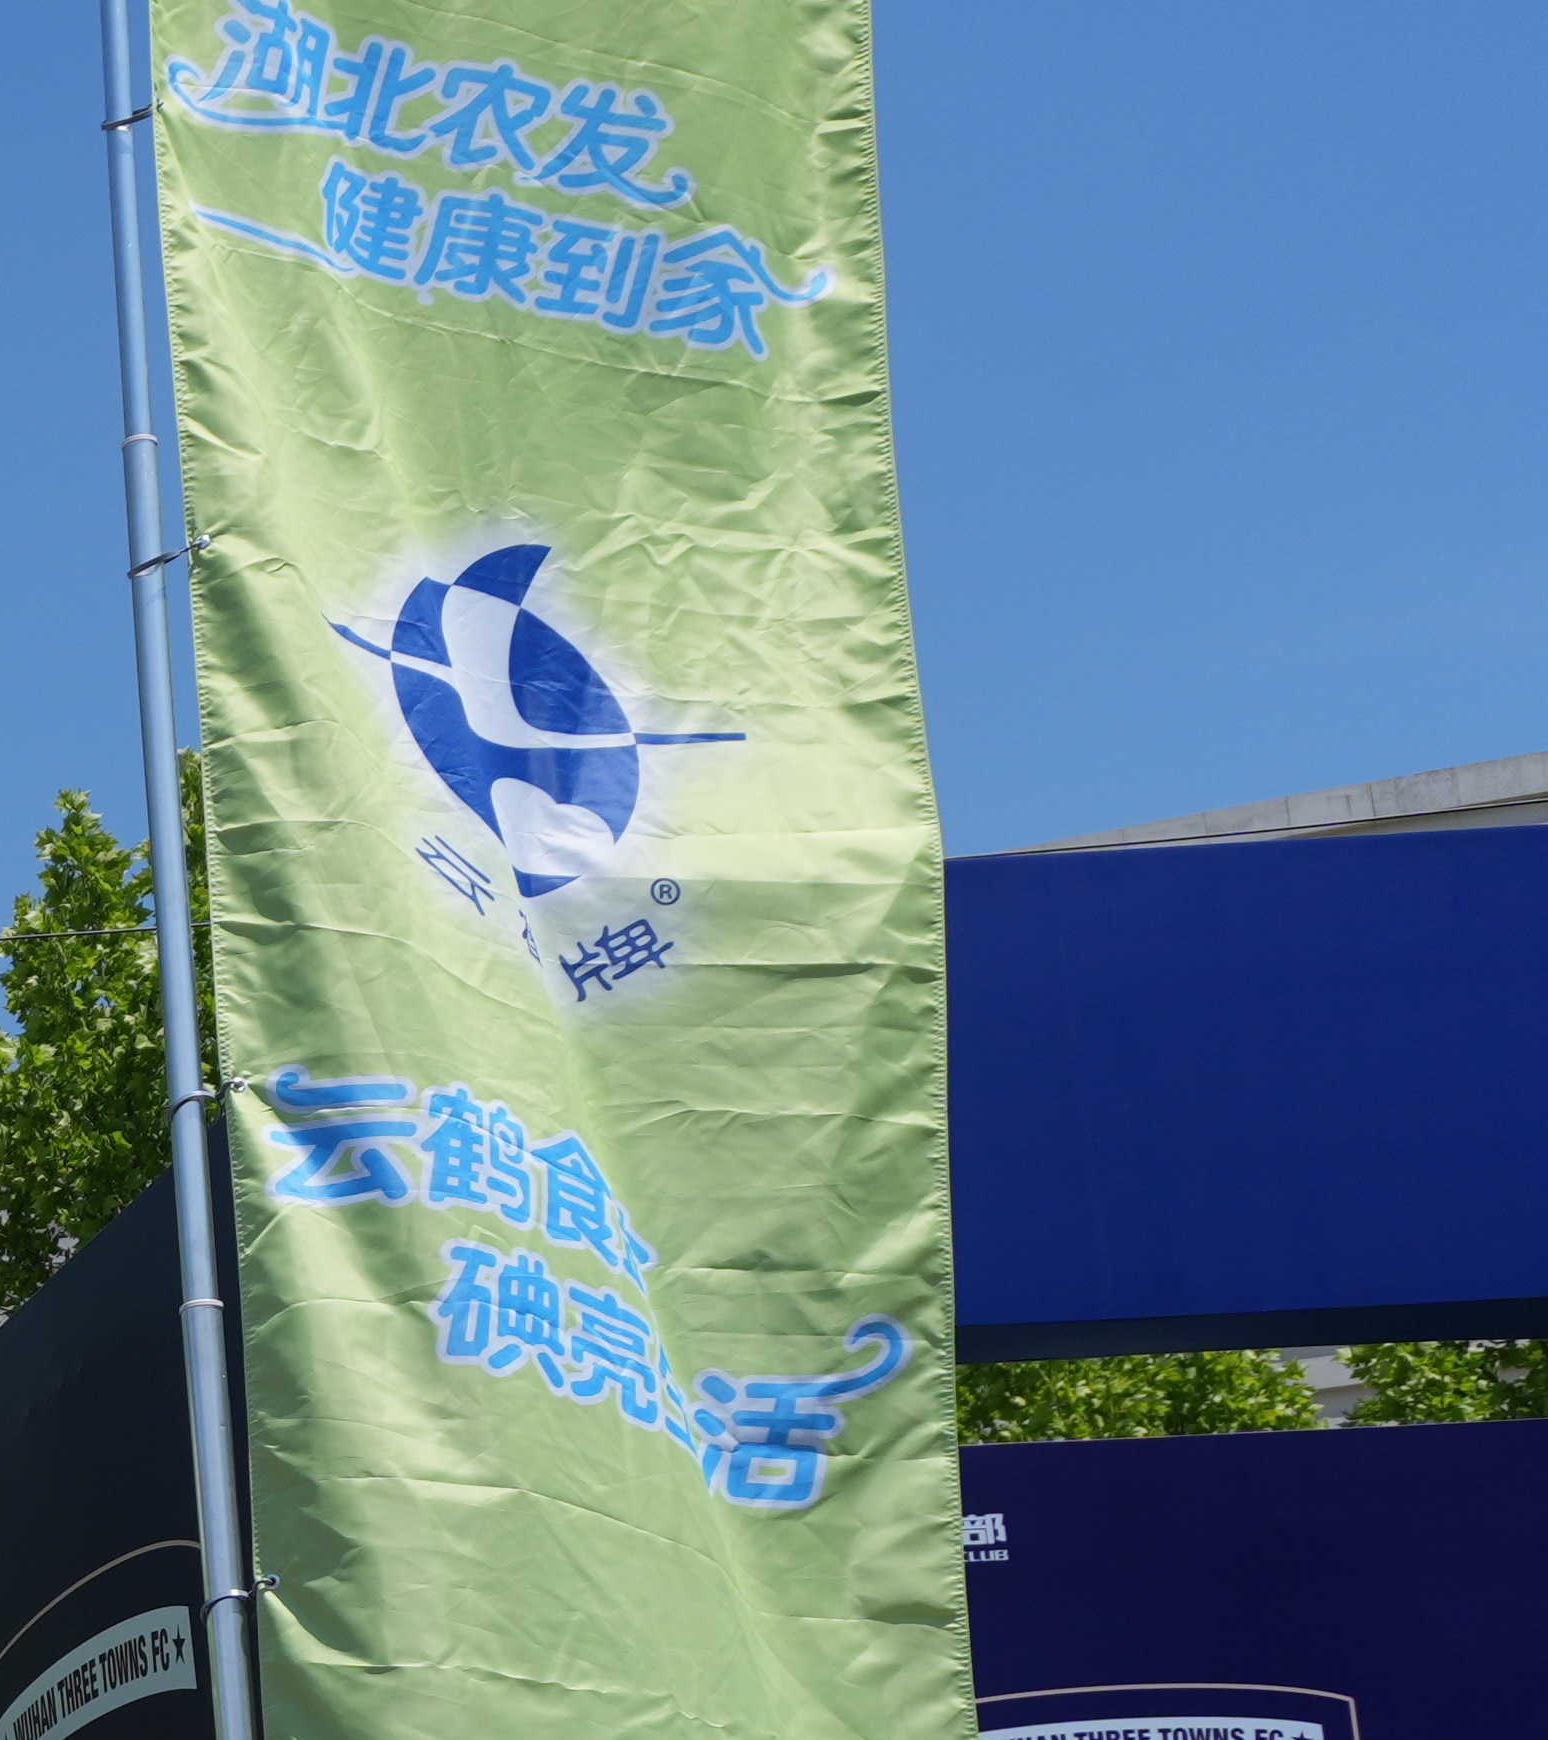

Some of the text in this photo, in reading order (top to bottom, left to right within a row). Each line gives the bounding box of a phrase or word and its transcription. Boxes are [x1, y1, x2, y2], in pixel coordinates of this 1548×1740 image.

[168, 0, 691, 206] 湖北农发
[256, 160, 816, 356] 健康到家
[56, 1656, 99, 1714] THREE
[97, 1635, 150, 1694] TOWNS
[150, 1629, 171, 1675] FC
